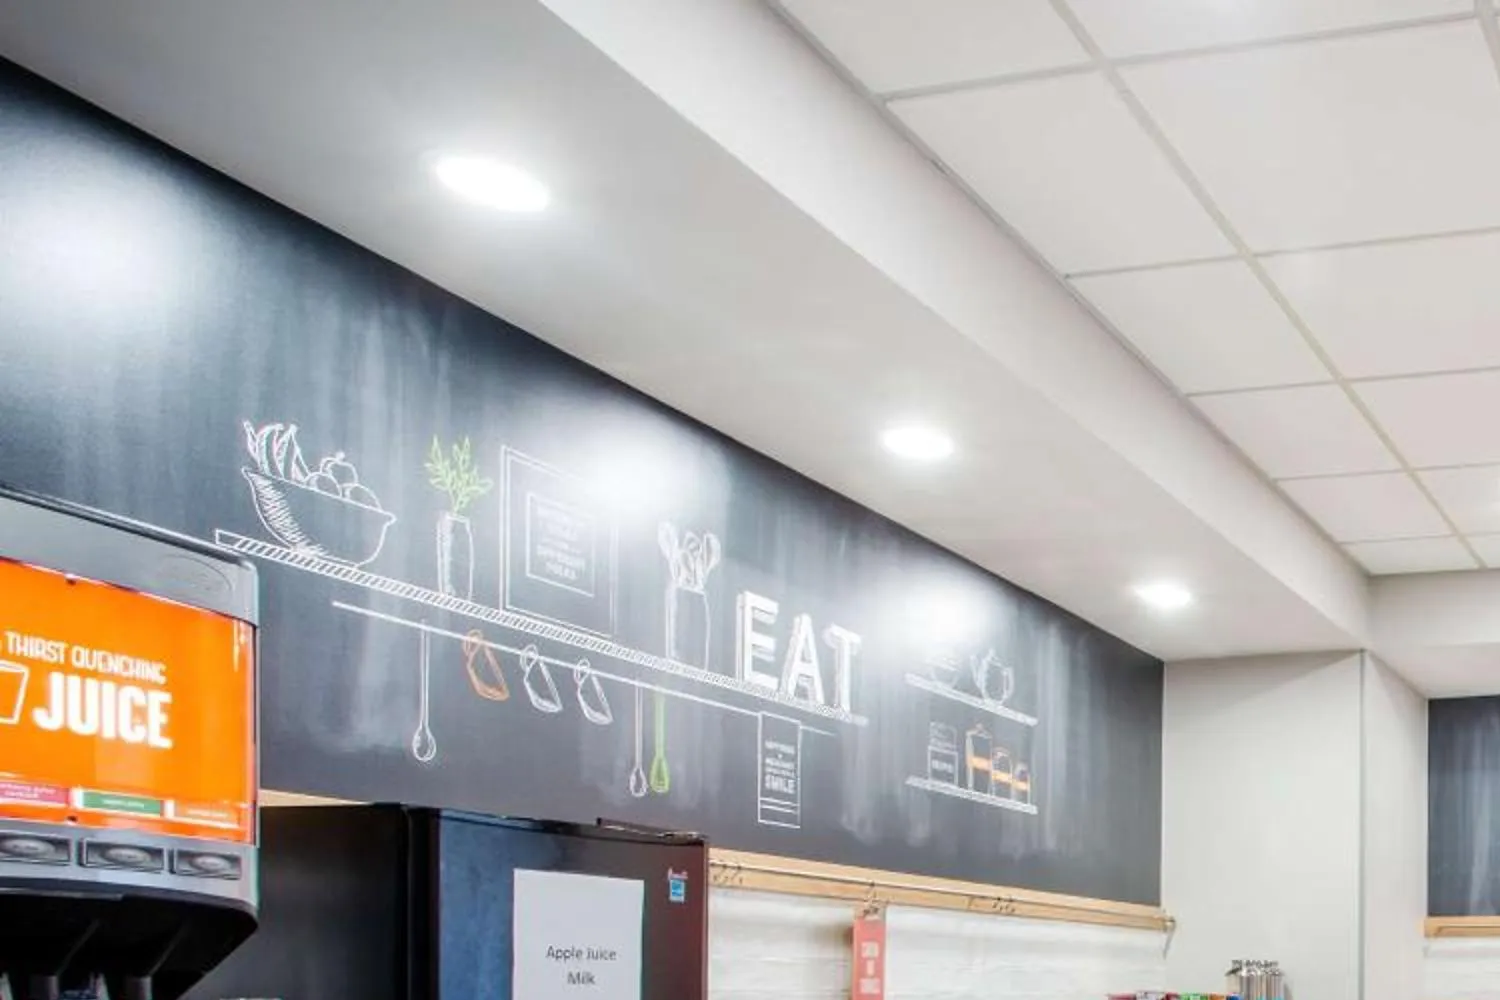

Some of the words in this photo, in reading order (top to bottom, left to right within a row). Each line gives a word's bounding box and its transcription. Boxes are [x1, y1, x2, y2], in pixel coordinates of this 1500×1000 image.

[5, 630, 68, 665] THIRST
[71, 644, 167, 685] QUENCHING
[736, 590, 862, 719] EAT
[32, 670, 173, 750] JUICE
[545, 945, 583, 964] Apple
[586, 946, 617, 961] Juice
[567, 971, 596, 985] Milk
